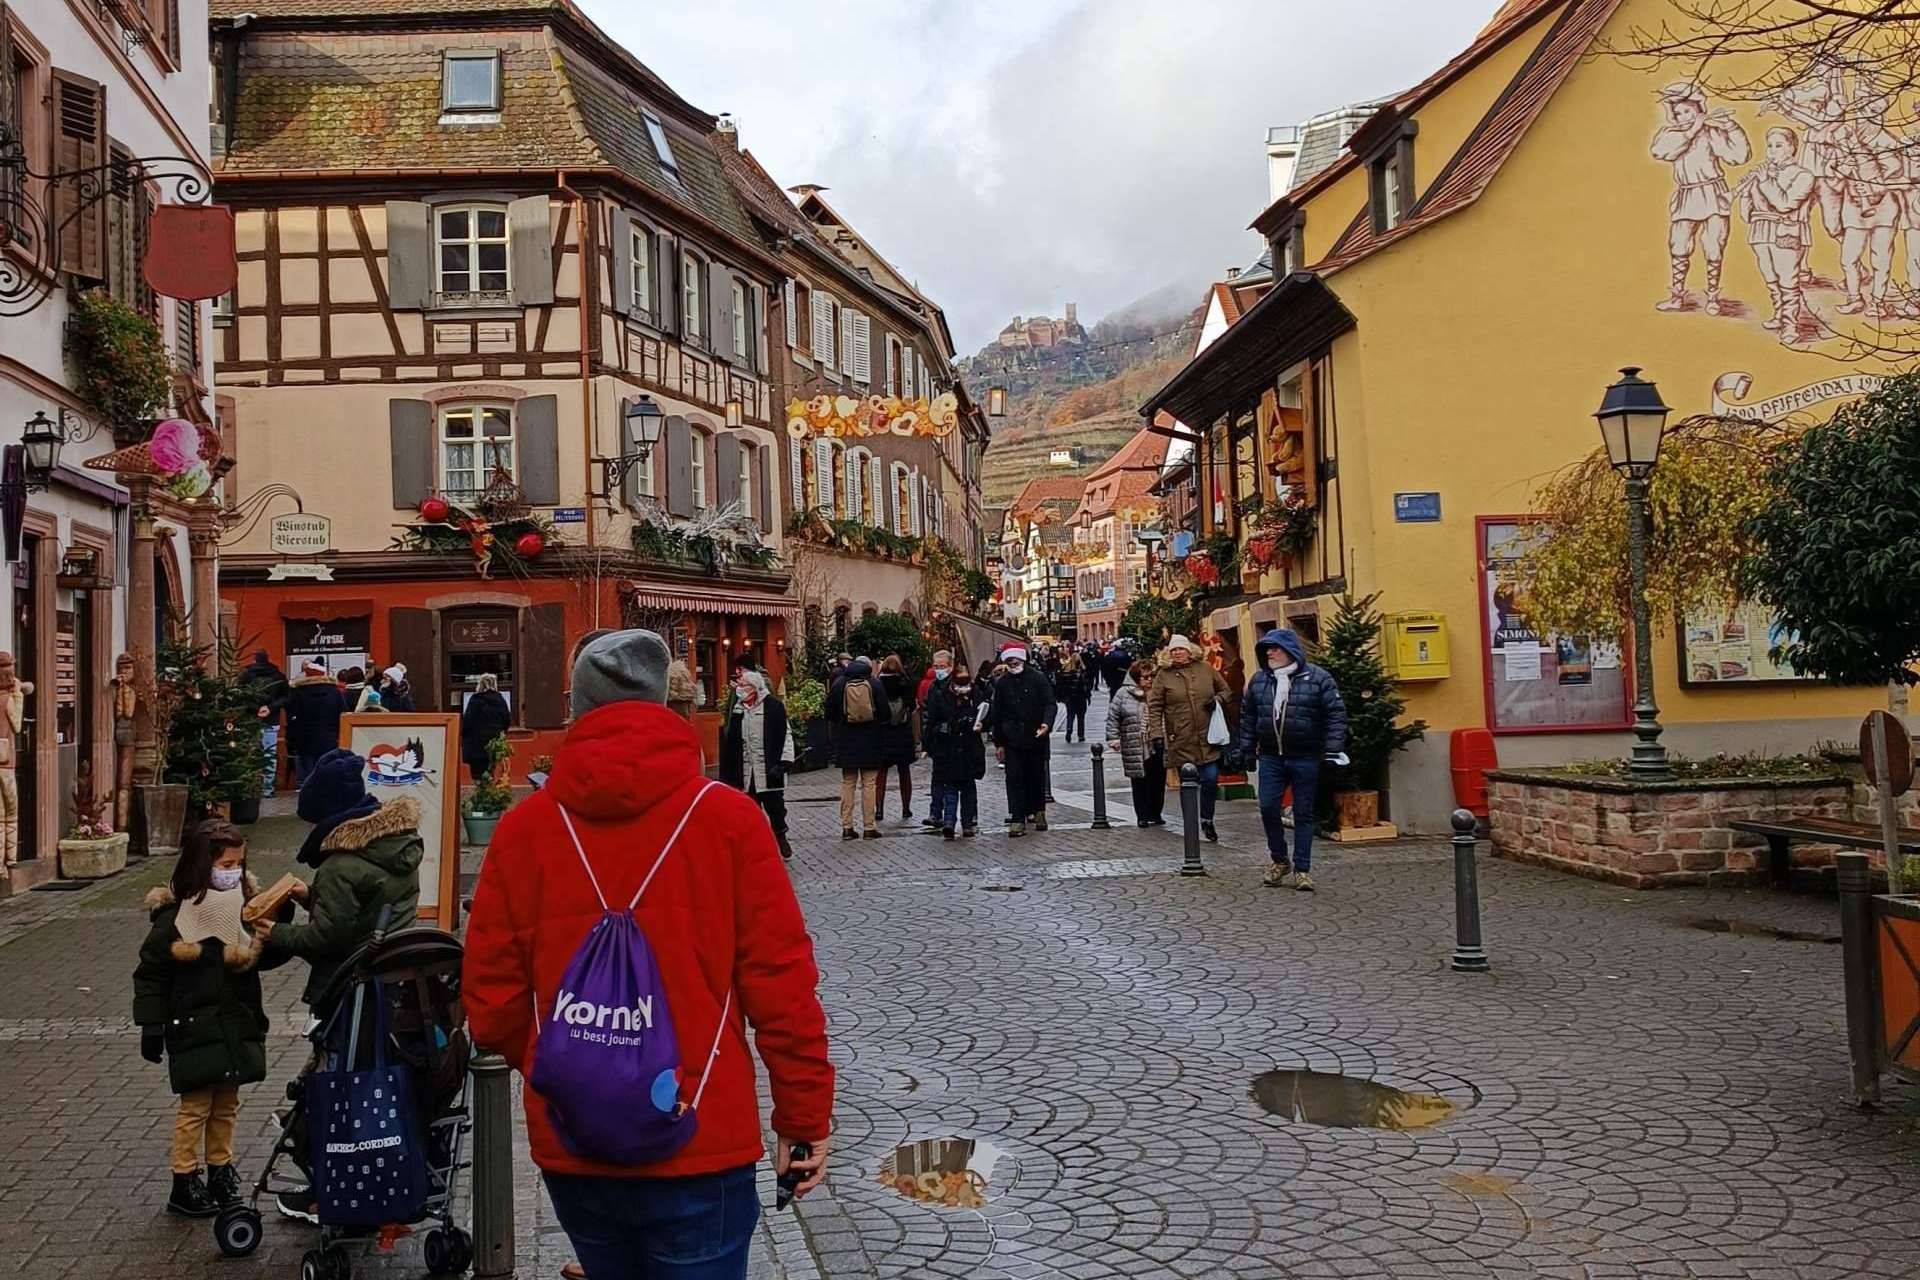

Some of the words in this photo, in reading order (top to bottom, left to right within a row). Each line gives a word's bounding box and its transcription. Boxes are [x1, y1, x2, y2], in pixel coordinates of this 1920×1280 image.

[276, 520, 325, 532] Winstub
[275, 534, 326, 546] Bierstub
[583, 1029, 606, 1043] best
